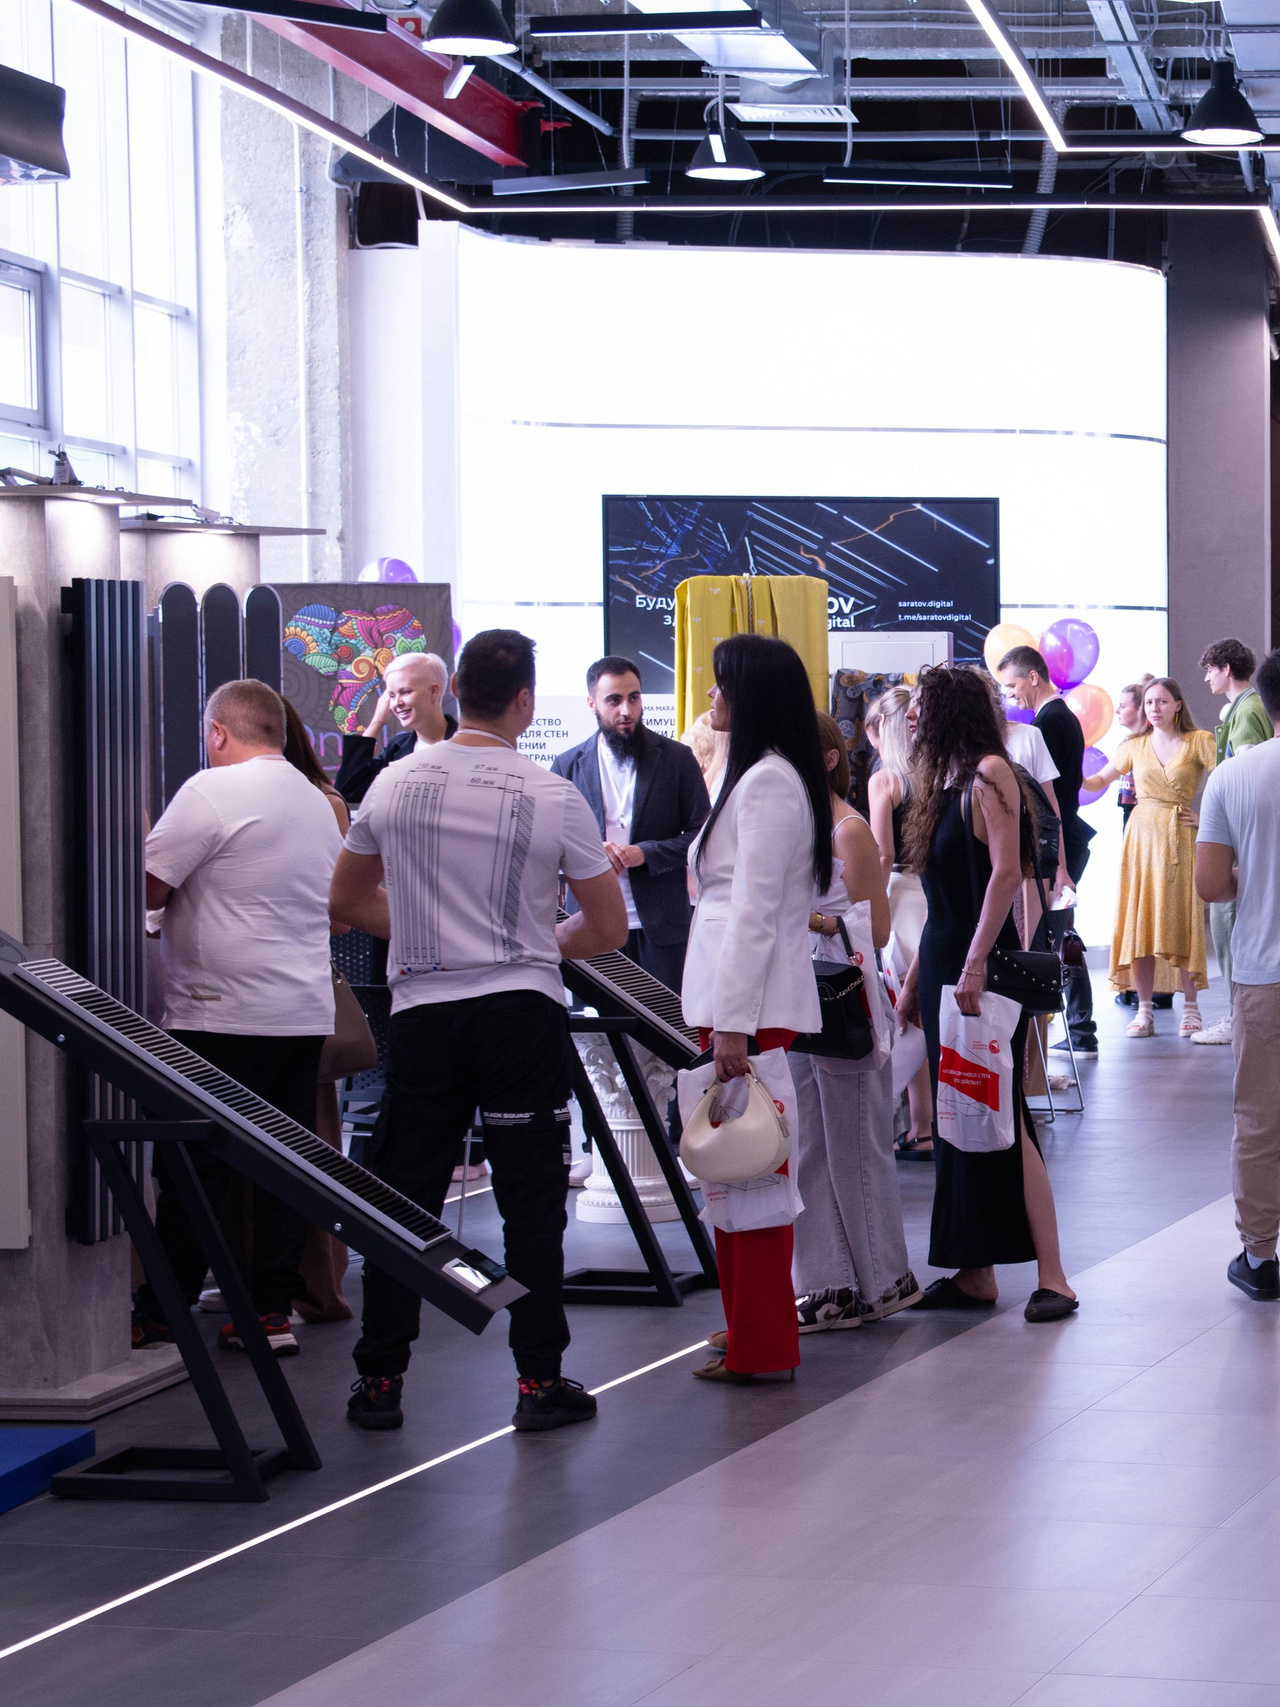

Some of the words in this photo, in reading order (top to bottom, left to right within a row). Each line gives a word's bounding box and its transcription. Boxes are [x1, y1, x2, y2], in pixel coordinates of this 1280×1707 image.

[898, 600, 954, 608] saratov.digital
[898, 614, 972, 622] t.me/saratovdigital
[544, 730, 569, 738] СТЕН
